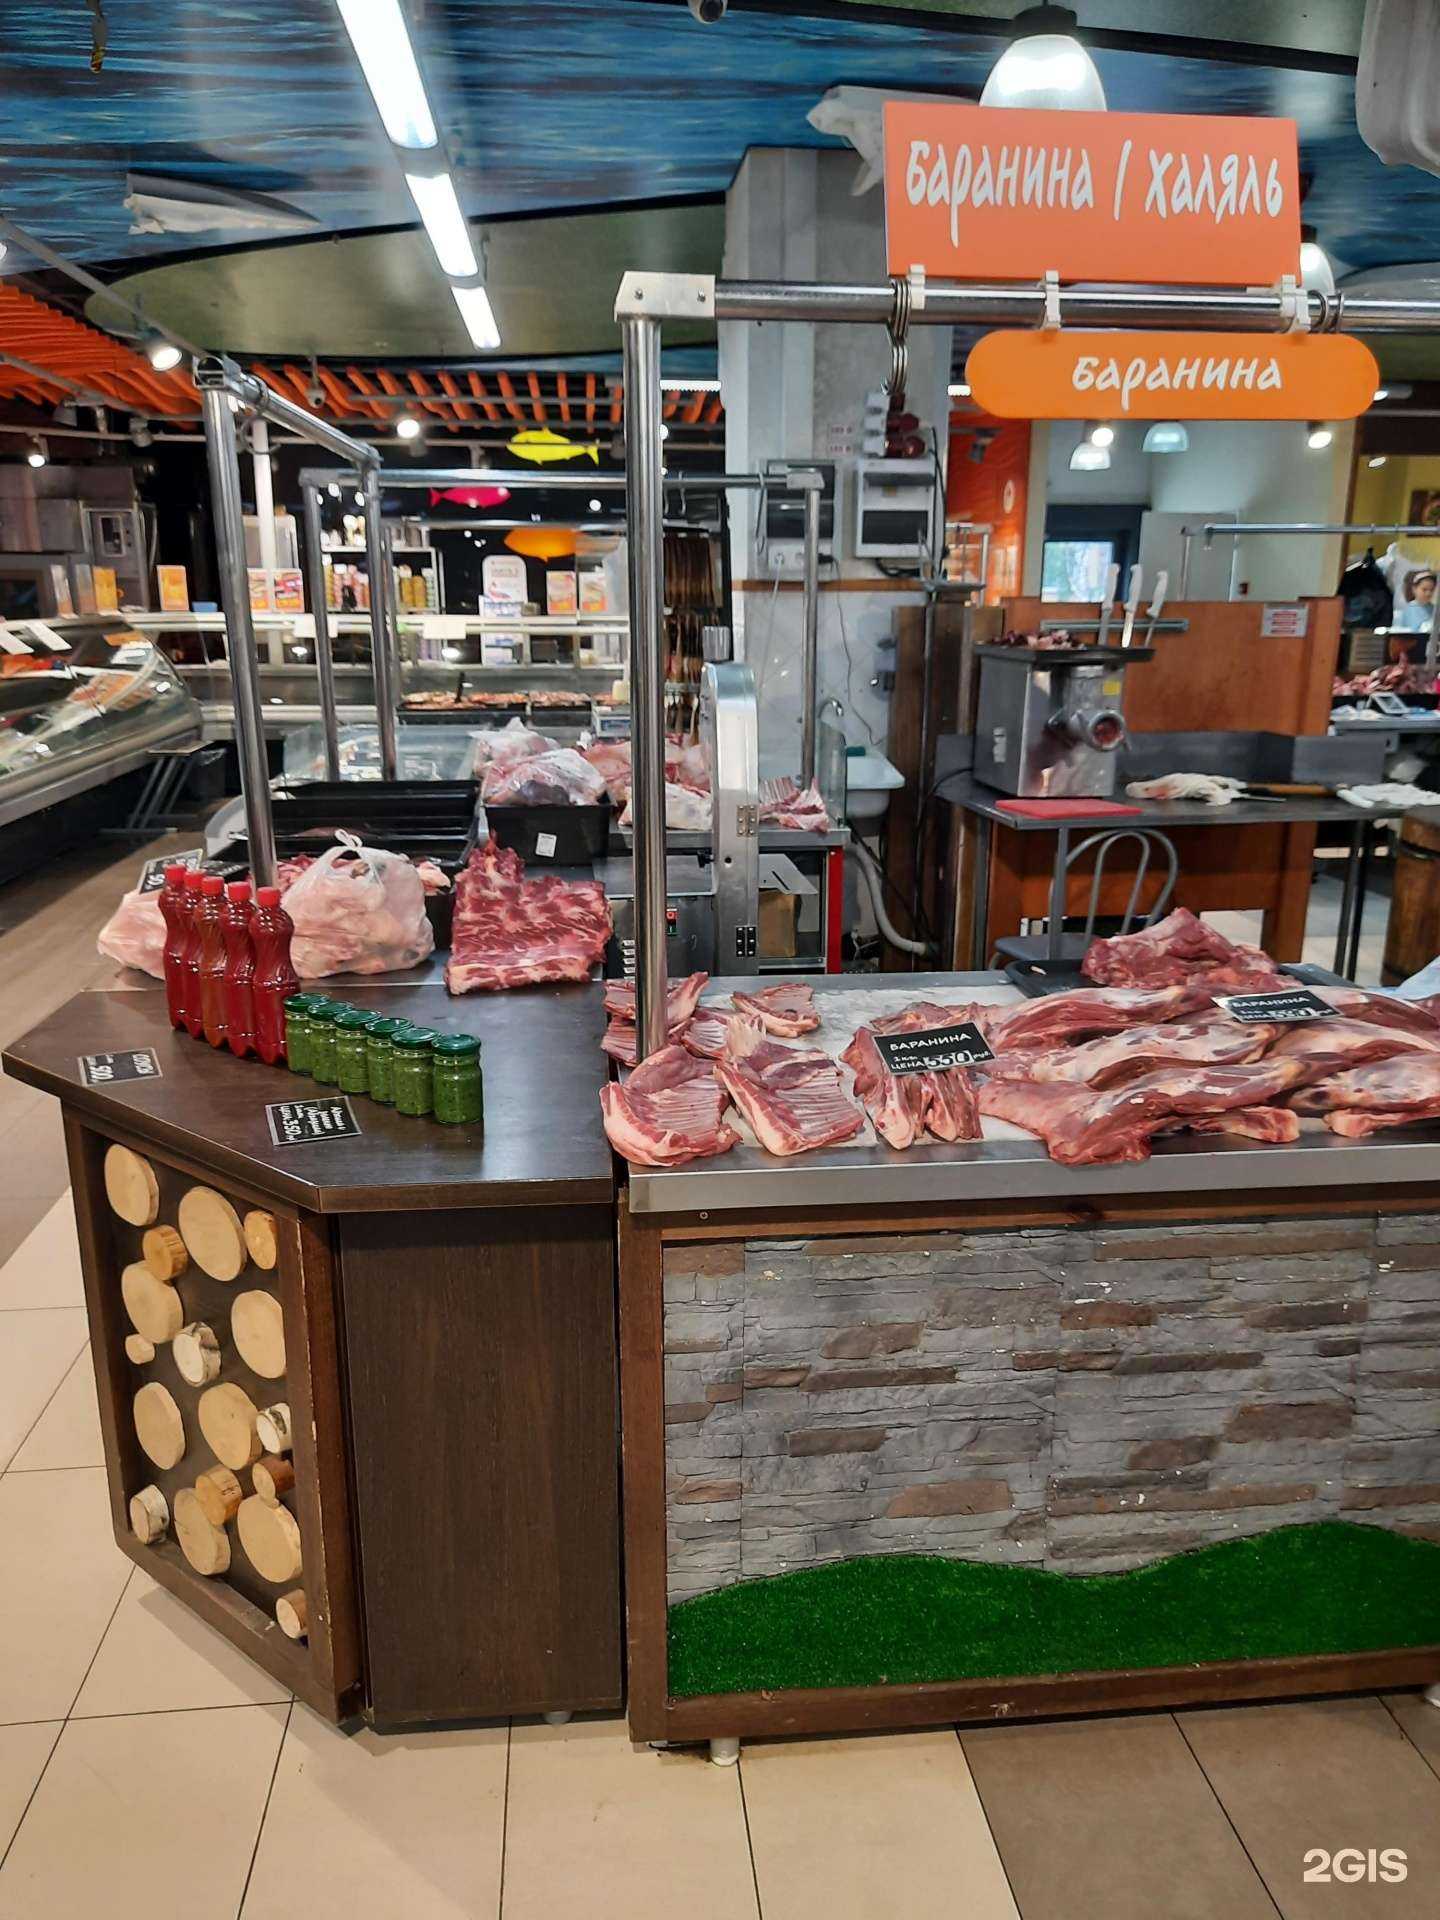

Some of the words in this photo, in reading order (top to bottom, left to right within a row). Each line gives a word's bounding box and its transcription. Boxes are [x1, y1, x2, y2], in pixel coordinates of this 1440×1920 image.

[1231, 996, 1311, 1008] БАРАНИНА
[889, 1033, 972, 1051] БАРАНИНА
[891, 1060, 925, 1070] ЦЕНА
[924, 1050, 971, 1068] 550
[283, 1119, 302, 1135] 350
